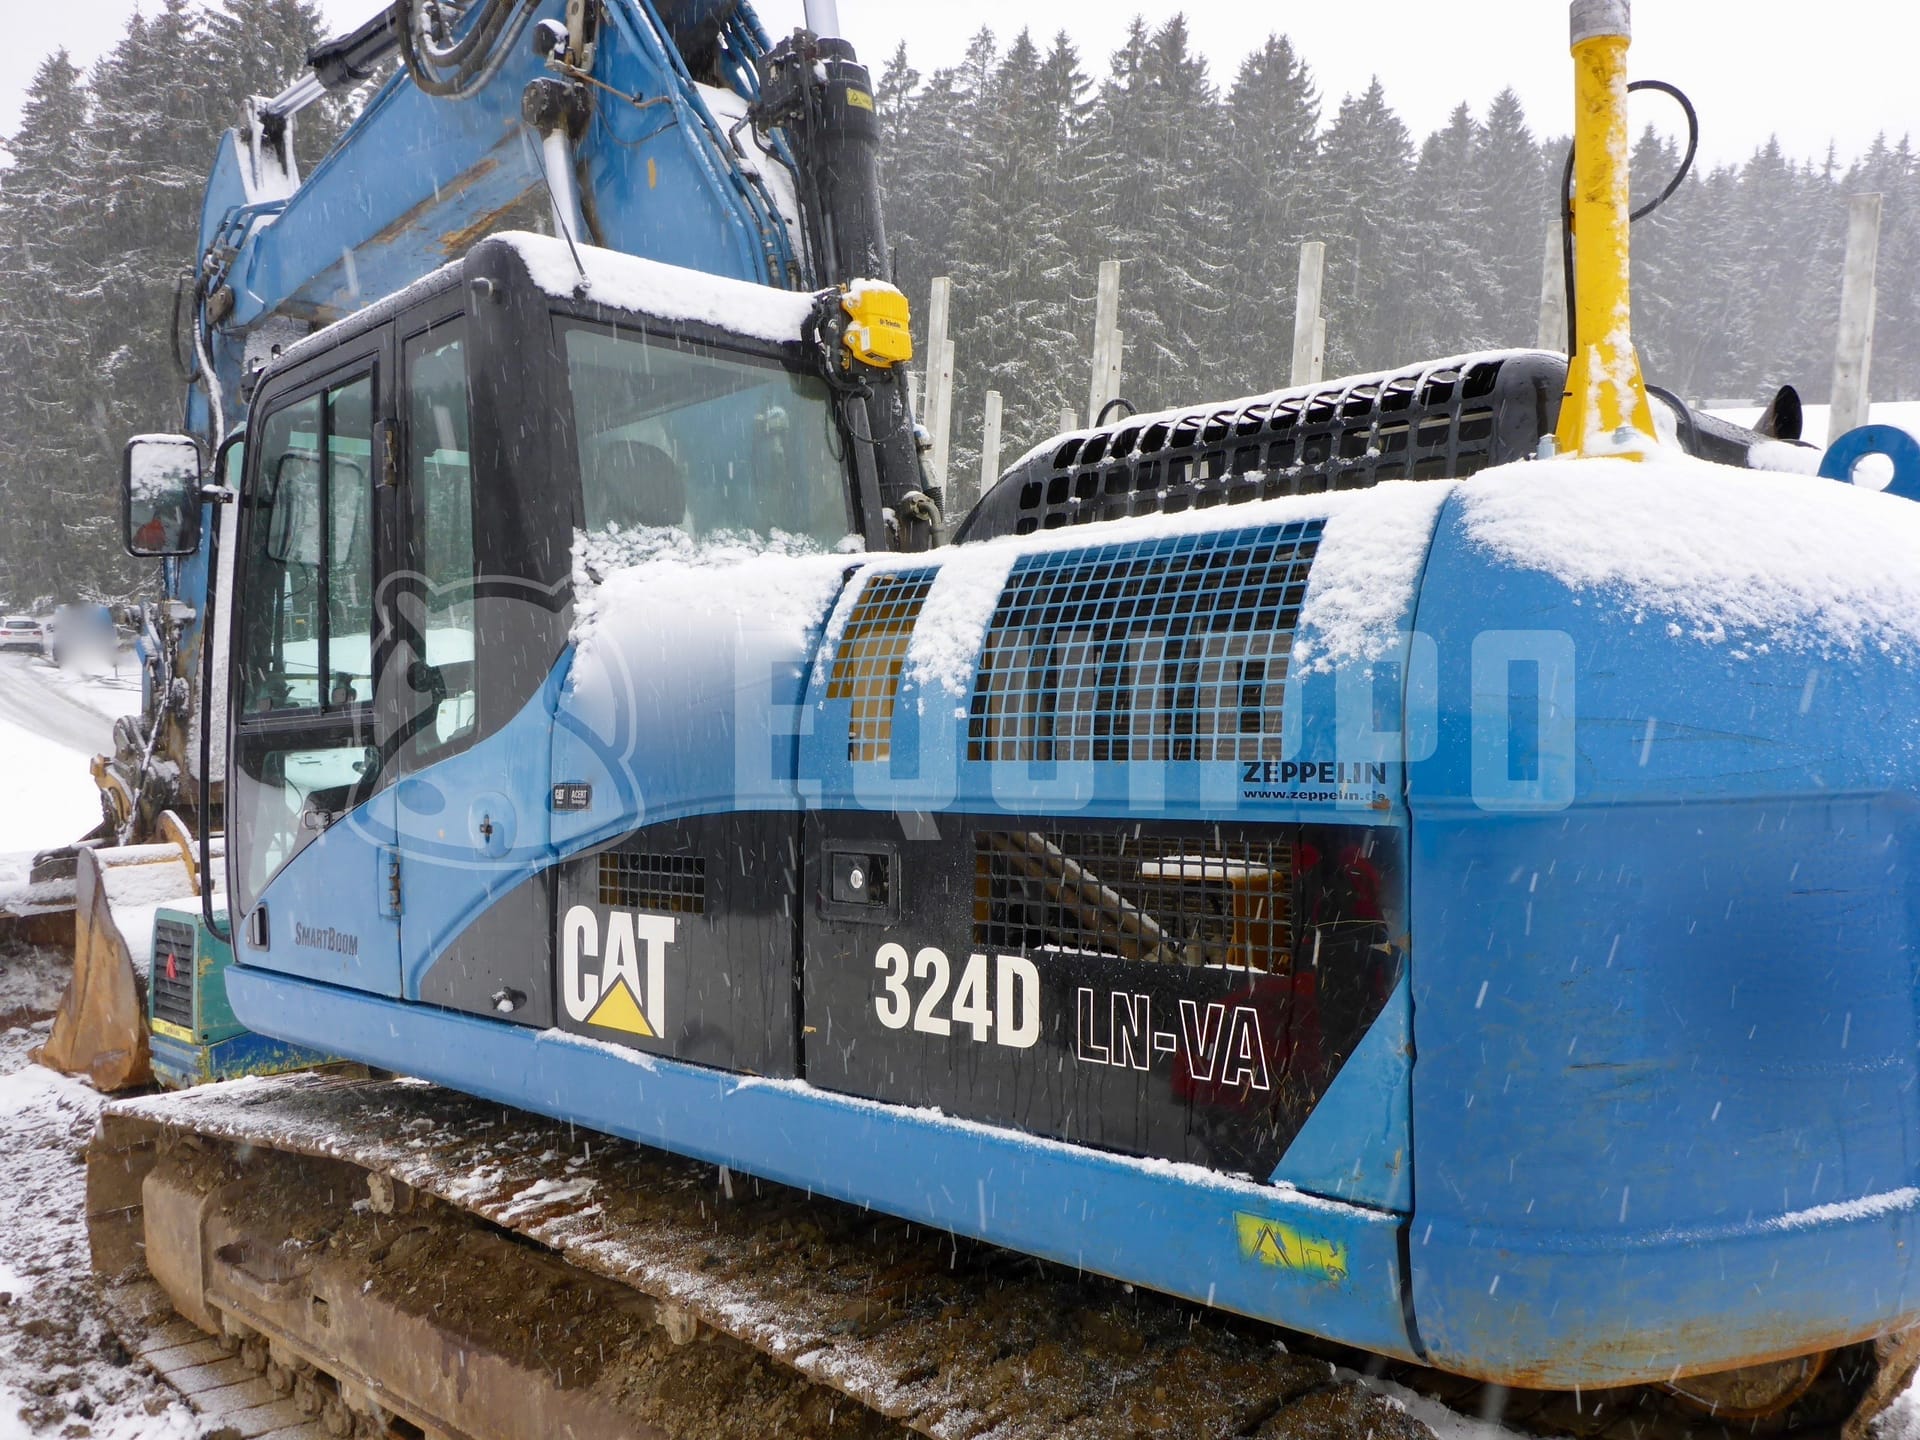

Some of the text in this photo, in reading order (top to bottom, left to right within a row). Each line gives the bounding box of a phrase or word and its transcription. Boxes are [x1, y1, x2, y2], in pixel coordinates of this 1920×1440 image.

[1243, 761, 1386, 784] ZEPPELIN
[563, 905, 675, 1039] CAT
[875, 942, 1270, 1090] 324D LN-VA
